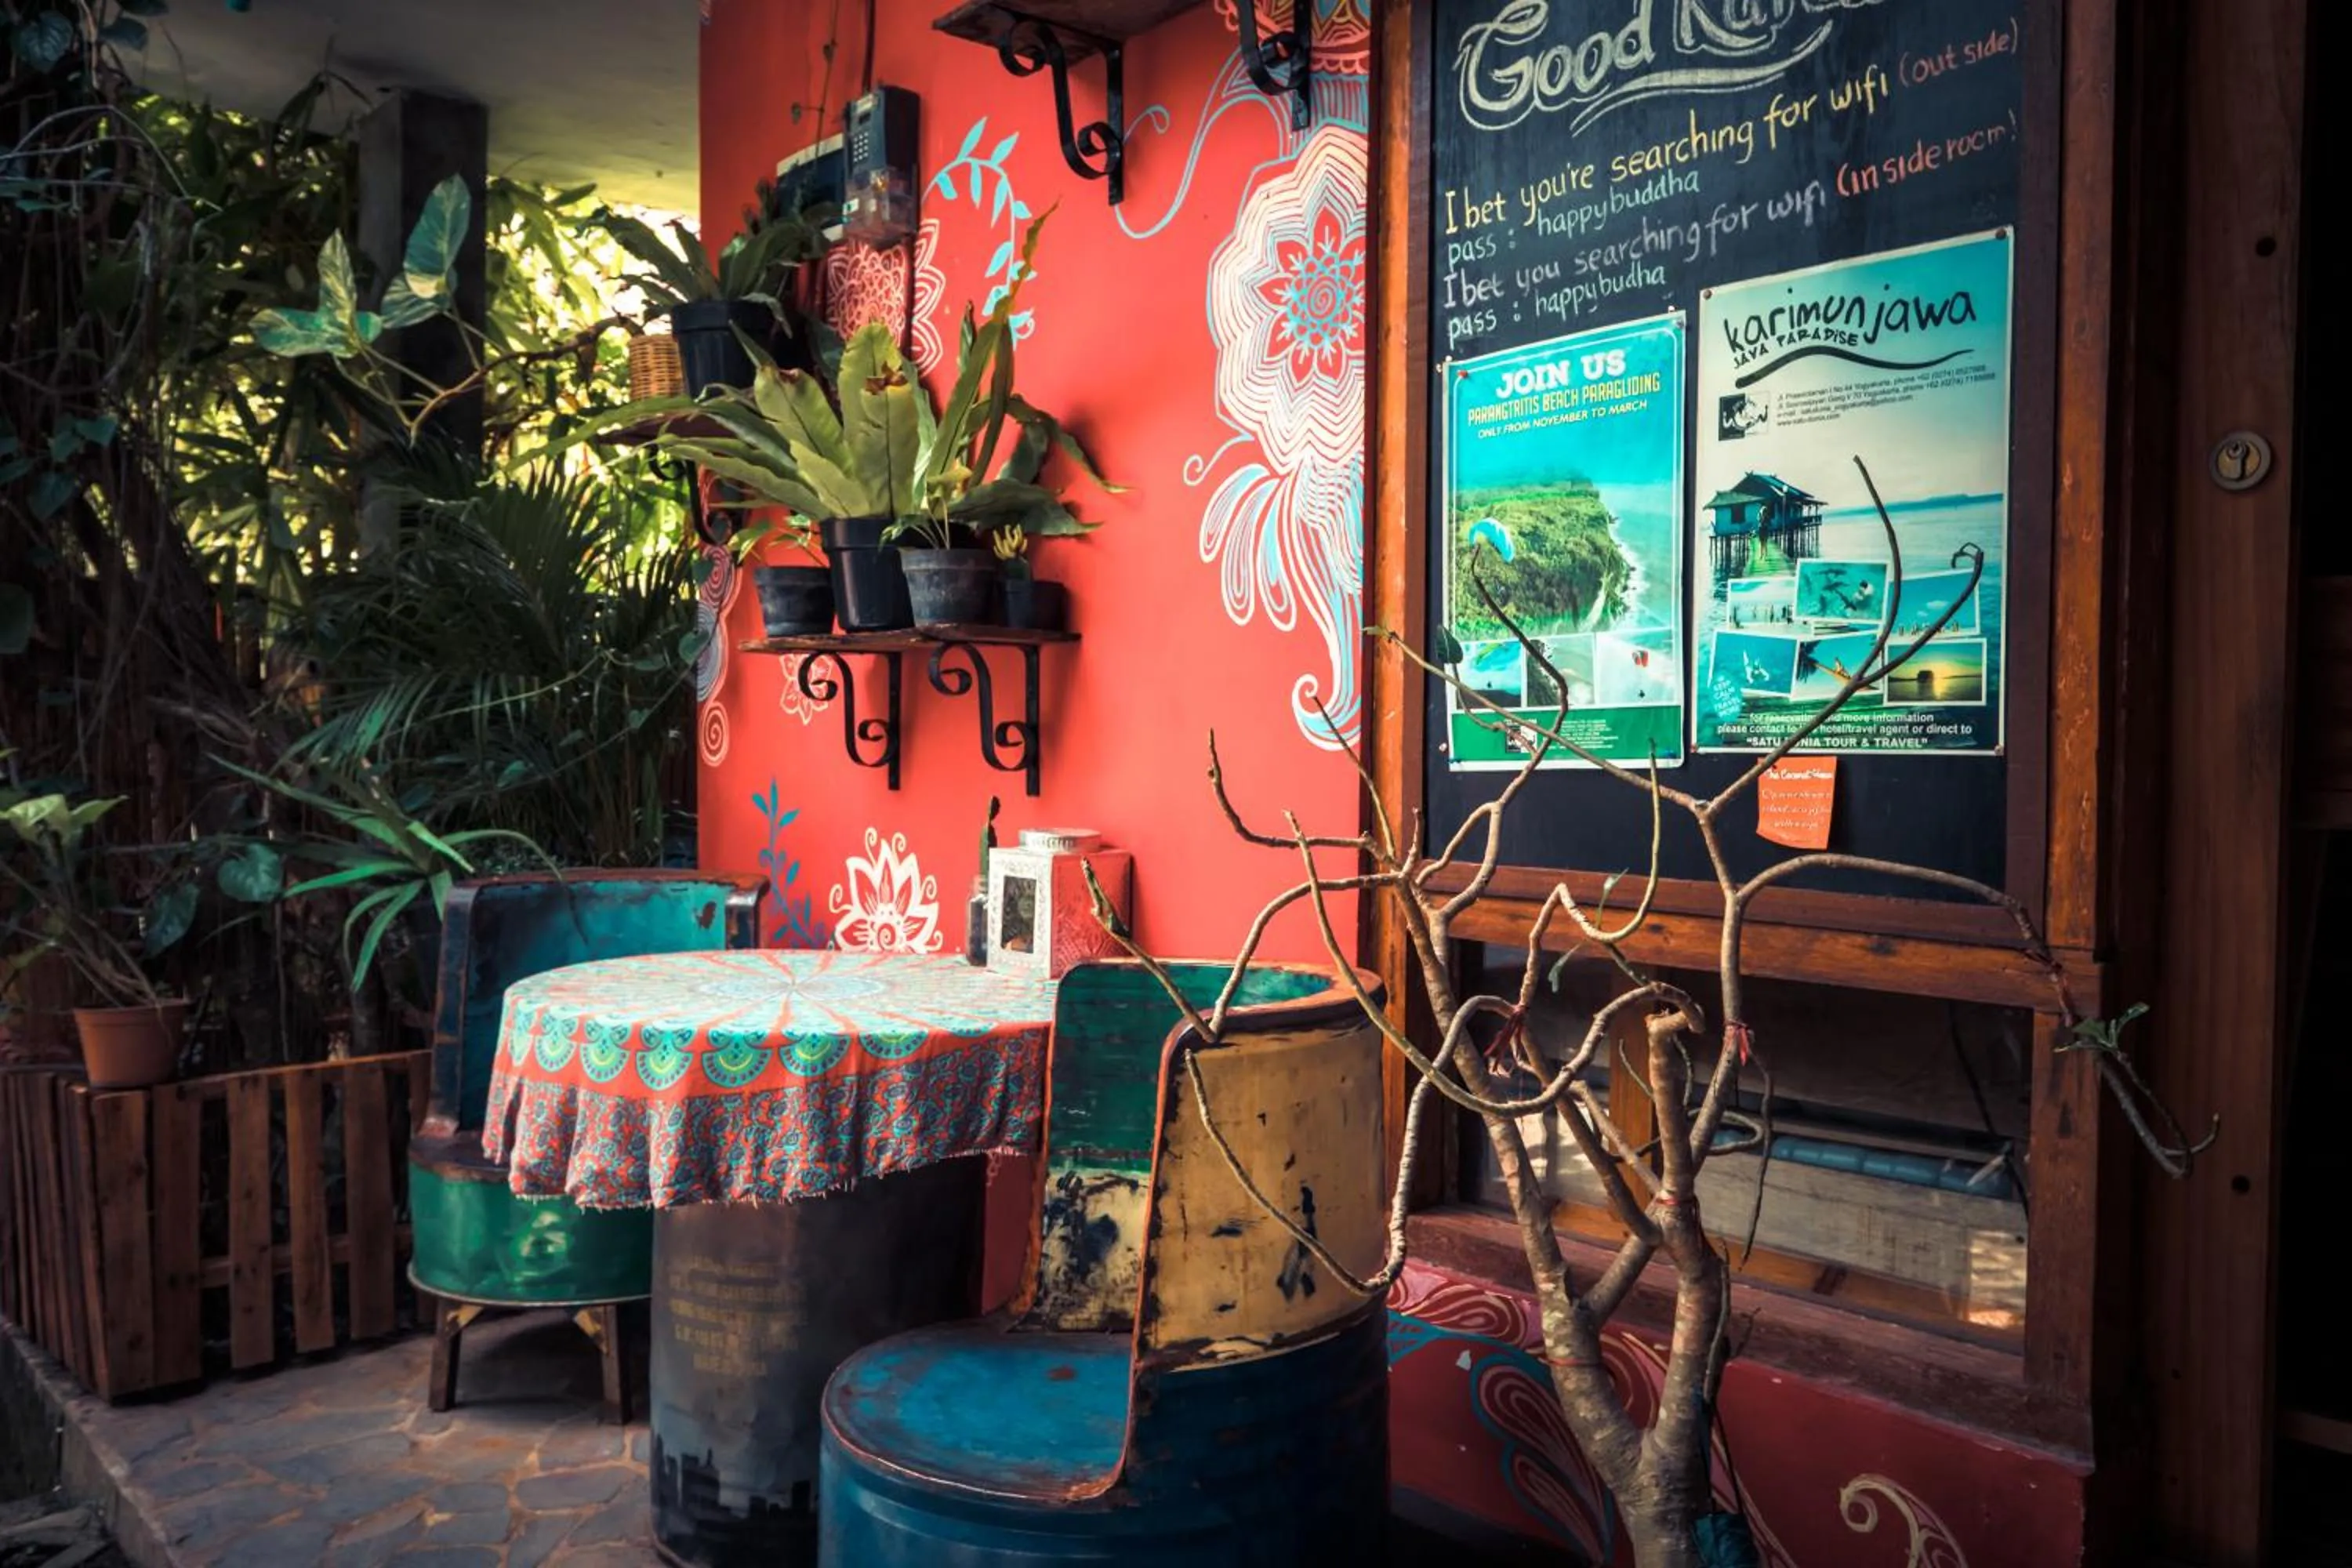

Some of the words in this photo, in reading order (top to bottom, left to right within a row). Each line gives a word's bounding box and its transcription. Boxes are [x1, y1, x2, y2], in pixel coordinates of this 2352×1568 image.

[1454, 0, 1657, 118] Good
[1445, 190, 1459, 234] I
[1463, 186, 1507, 229] bet
[1519, 162, 1595, 227] you're
[1610, 108, 1755, 182] searching
[1763, 93, 1819, 150] for
[1830, 64, 1889, 114] wifi
[1447, 233, 1497, 275] pass
[1537, 169, 1701, 240] happybuddha
[1460, 267, 1506, 308] bet
[1515, 260, 1561, 298] you
[1574, 216, 1701, 274] searching
[1704, 201, 1759, 257] for
[1766, 179, 1827, 227] wifi
[1448, 309, 1497, 350] pass
[1534, 260, 1667, 321] happybudha
[1723, 283, 1977, 353] karimunjawa
[1495, 359, 1570, 400] JOIN
[1580, 347, 1627, 381] US
[1733, 343, 1769, 369] JAVA
[1503, 419, 1532, 435] FROM
[1532, 408, 1589, 428] NOVEMBER
[1592, 406, 1606, 418] TO
[1607, 398, 1648, 416] MARCH
[1542, 387, 1579, 412] BEACH
[1581, 371, 1661, 405] PARAGLIDING
[1718, 724, 1748, 735] please
[1749, 724, 1785, 734] contact
[1879, 724, 1909, 736] agent
[1912, 725, 1924, 735] or
[1926, 724, 1958, 735] direct
[1961, 724, 1973, 735] to
[1824, 737, 1857, 747] TOUR
[1860, 737, 1870, 748] &
[1843, 713, 1870, 722] more
[1872, 712, 1934, 723] information
